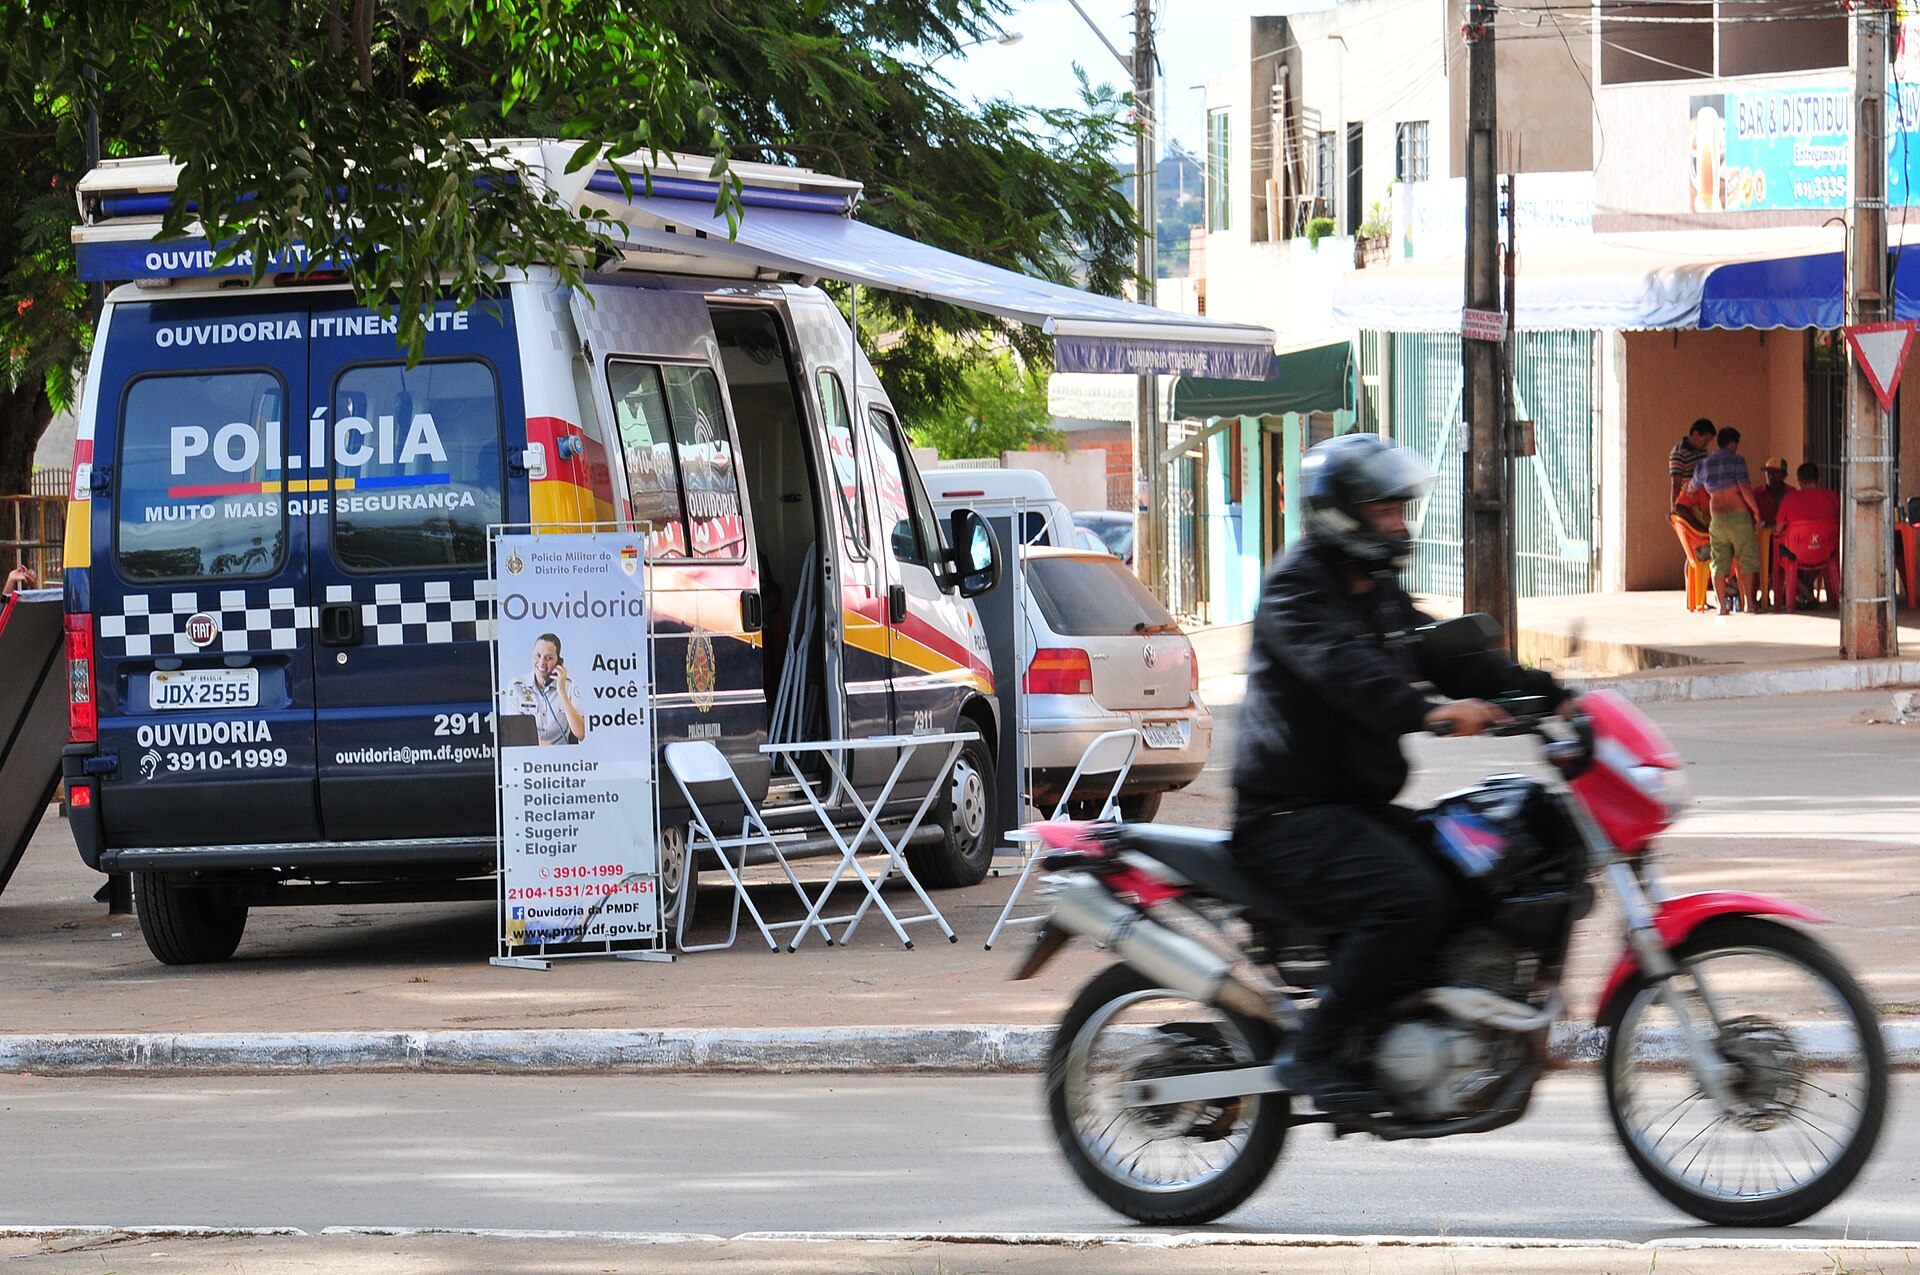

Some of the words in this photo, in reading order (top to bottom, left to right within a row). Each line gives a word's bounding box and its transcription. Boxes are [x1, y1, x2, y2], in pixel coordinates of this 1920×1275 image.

[1738, 99, 1764, 136] BAR
[1768, 100, 1777, 134] &
[155, 318, 302, 348] OUVIDORIA
[310, 310, 469, 339] ITINERNTE
[170, 407, 447, 476] POLÍCIA
[145, 503, 216, 522] MUITO
[224, 501, 279, 520] MAIS
[287, 498, 330, 517] QUE
[336, 490, 475, 514] SEGURANÇA
[688, 492, 738, 518] OUVIDORIA
[531, 551, 562, 563] Polícia
[565, 551, 597, 562] Militar
[599, 551, 611, 561] do
[535, 565, 570, 576] Distrito
[572, 563, 609, 574] Federal
[503, 590, 643, 621] Ouvidoria
[192, 620, 211, 640] FIAT
[591, 652, 637, 676] Aqui
[593, 681, 638, 699] você
[588, 707, 645, 732] pode!
[914, 709, 933, 730] 2911
[136, 719, 272, 748] OUVIDORIA
[433, 711, 496, 736] 2911
[166, 748, 288, 772] 3910-1999
[335, 743, 496, 765] ouvidoria@pm.df.gov.br
[523, 760, 599, 774] Denunciar
[523, 776, 587, 791] Solicitar
[523, 791, 619, 807] Policiamento
[524, 808, 596, 823] Reclamar
[525, 825, 579, 841] Sugerir
[525, 842, 578, 857] Elogiar
[553, 864, 624, 879] 3910-1999
[508, 882, 654, 900] 2104-1531/2104-1451
[527, 905, 584, 919] Ouvidoria
[588, 904, 602, 915] da
[606, 902, 640, 914] PMDF
[513, 921, 652, 940] www.pmdf.df.gov.br
